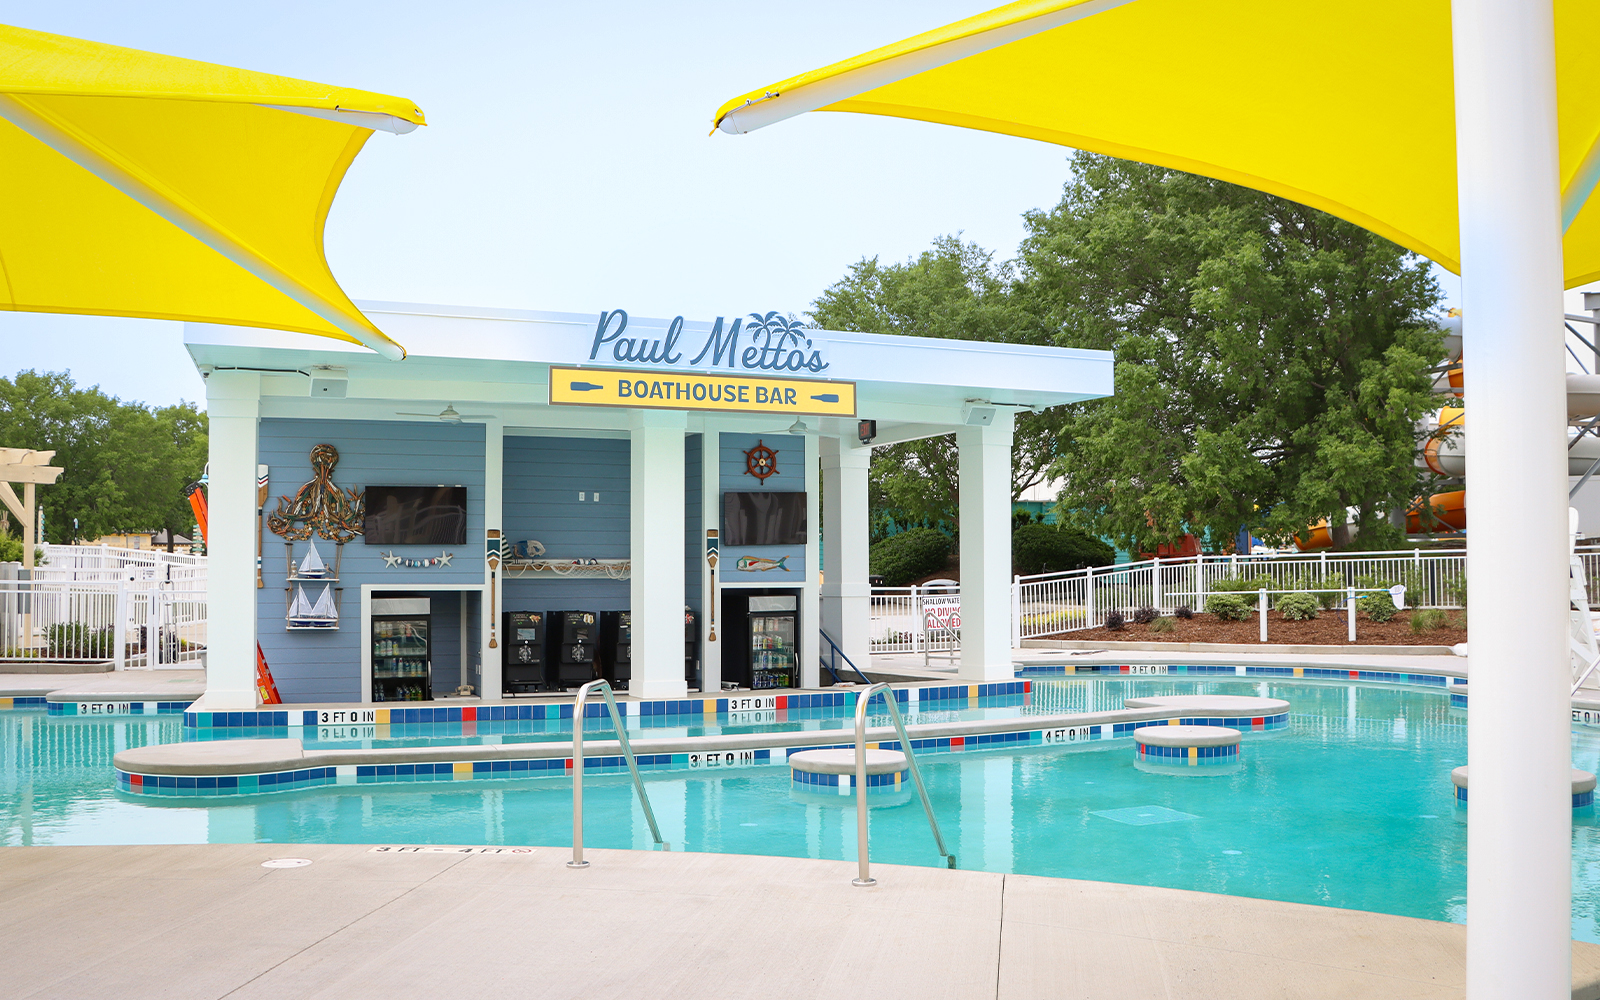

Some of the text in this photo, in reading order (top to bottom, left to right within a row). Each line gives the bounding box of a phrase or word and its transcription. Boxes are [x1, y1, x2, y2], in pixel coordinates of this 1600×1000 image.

[589, 309, 829, 373] Paul Metto's
[617, 379, 798, 405] BOATHOUSE BAR
[732, 700, 738, 710] 3
[742, 699, 752, 709] FT
[766, 698, 774, 708] IN
[322, 712, 328, 722] 3
[334, 712, 346, 722] FT
[363, 711, 374, 722] IN
